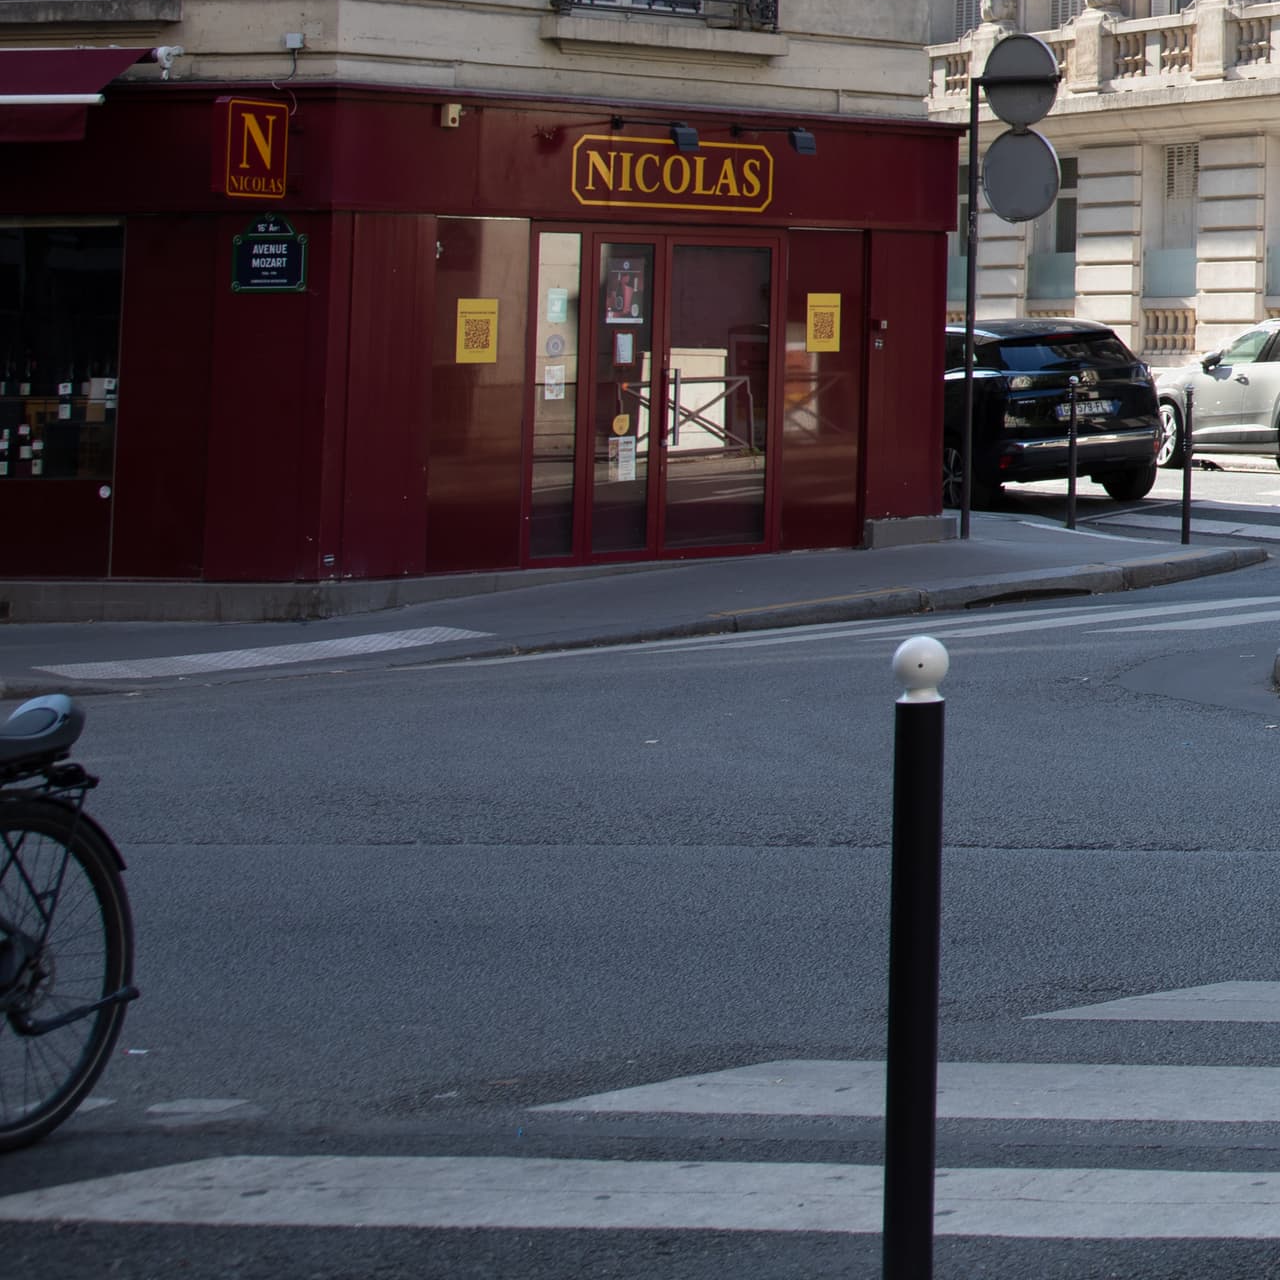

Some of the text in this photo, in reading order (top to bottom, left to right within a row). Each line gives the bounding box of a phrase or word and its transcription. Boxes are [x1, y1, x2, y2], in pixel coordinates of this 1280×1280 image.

[240, 113, 276, 170] N
[584, 150, 761, 197] NICOLAS
[230, 175, 284, 193] NICOLAS
[252, 244, 288, 254] AVENUE
[252, 257, 288, 268] MOZART
